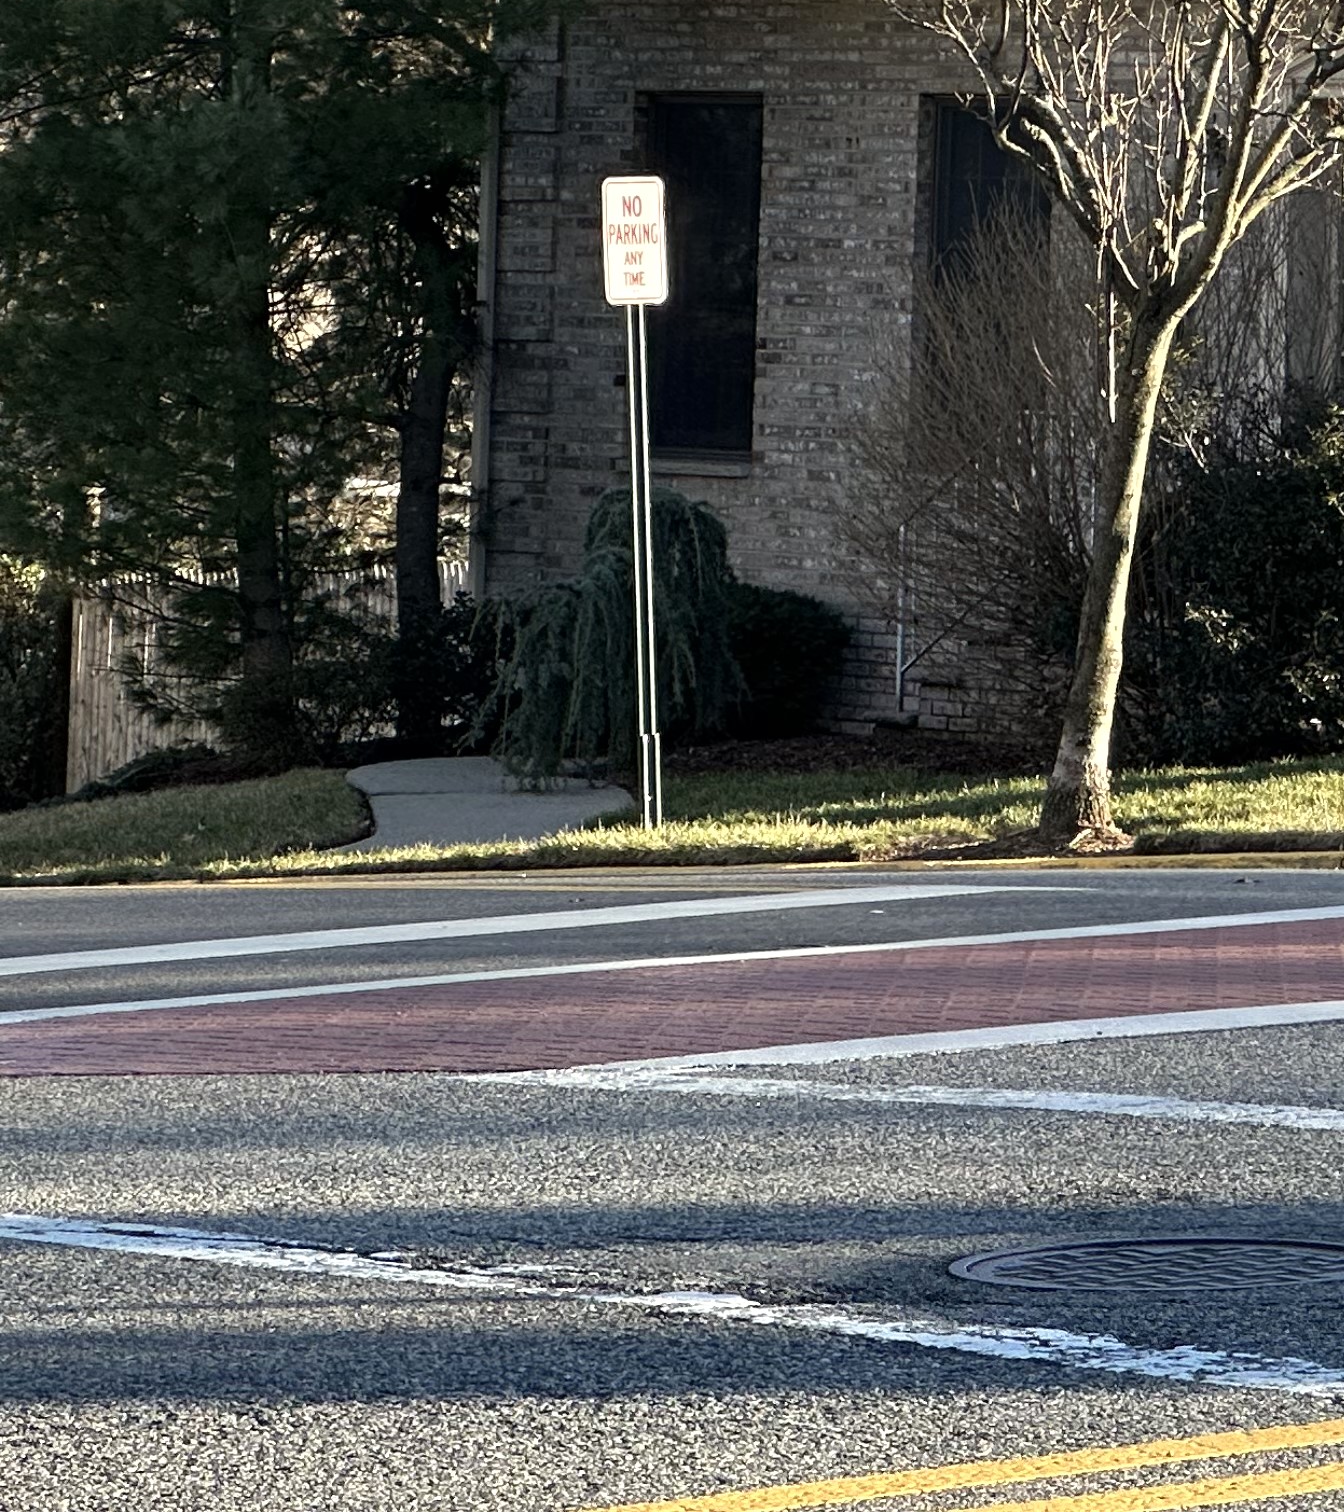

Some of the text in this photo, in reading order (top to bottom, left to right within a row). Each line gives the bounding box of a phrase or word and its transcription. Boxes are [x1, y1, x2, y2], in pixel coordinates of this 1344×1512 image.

[621, 195, 643, 217] NO
[608, 223, 659, 245] PARKING
[624, 251, 644, 265] ANY
[624, 271, 646, 286] TIME
